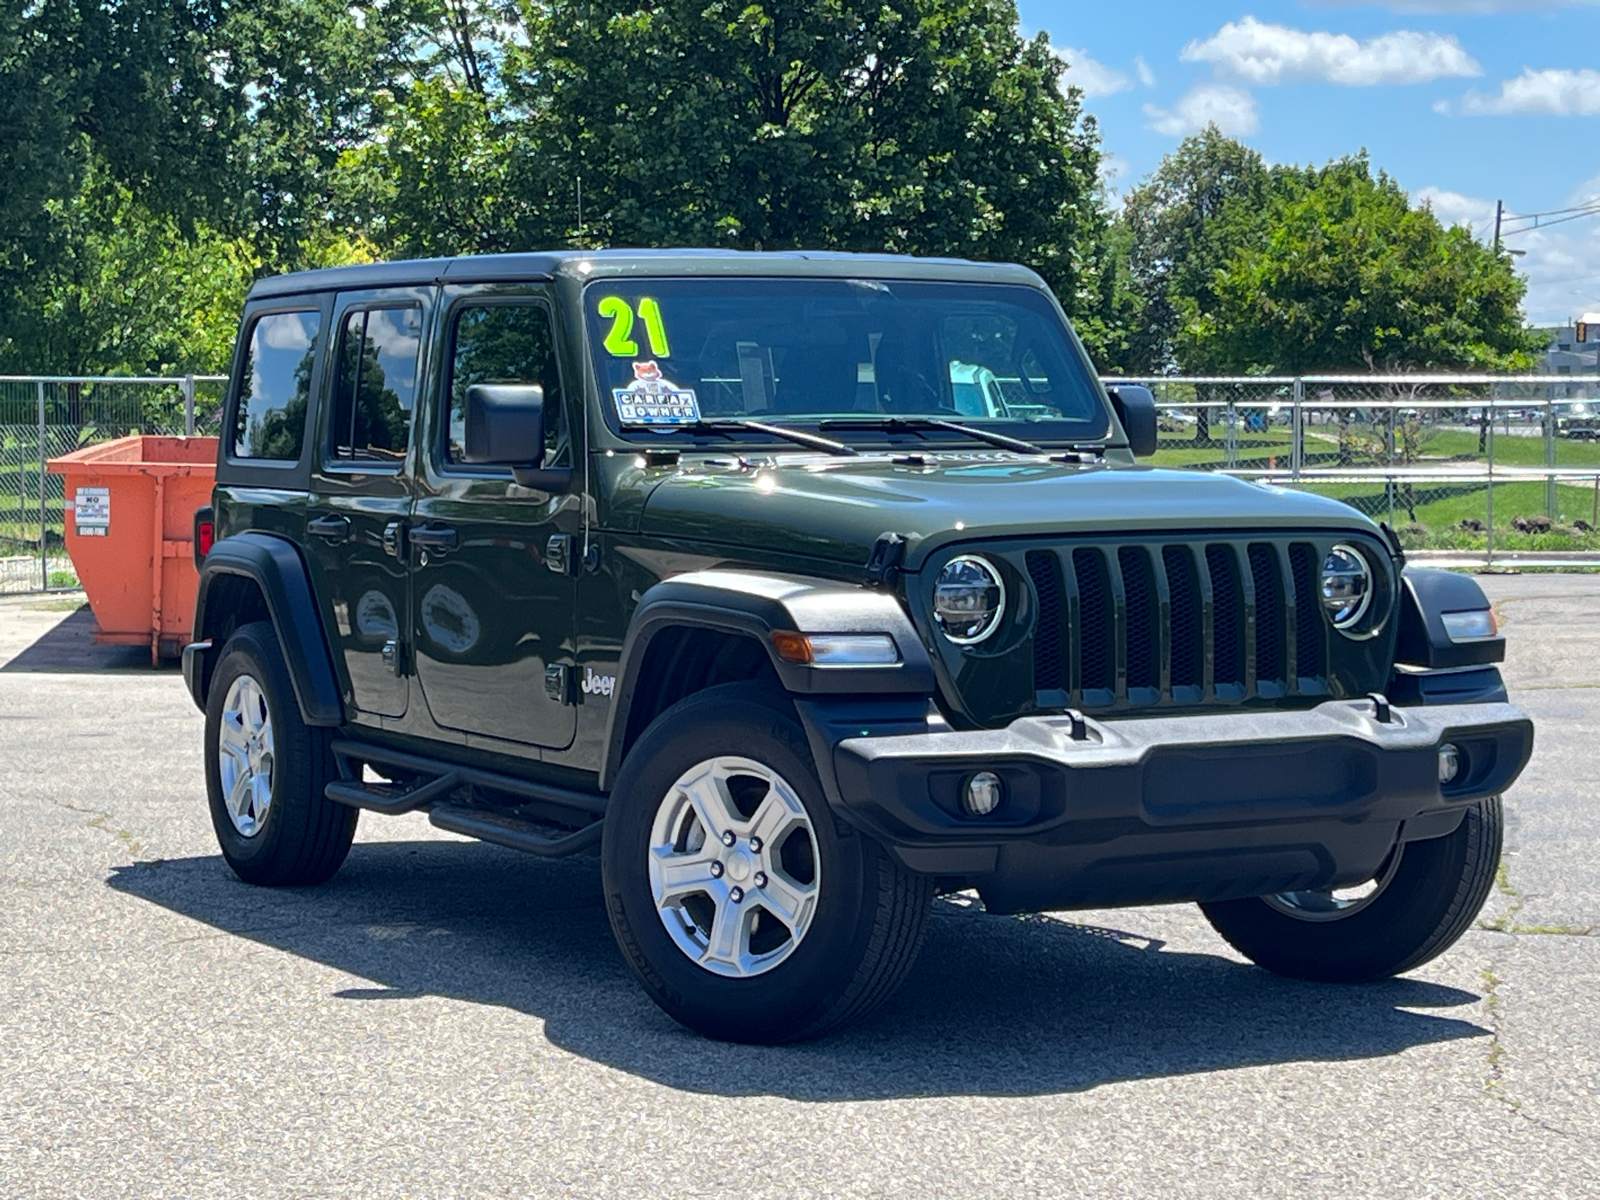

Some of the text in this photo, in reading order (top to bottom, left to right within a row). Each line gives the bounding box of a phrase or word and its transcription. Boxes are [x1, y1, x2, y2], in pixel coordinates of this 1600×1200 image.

[598, 296, 670, 358] 21
[620, 394, 692, 406] CARFAX
[636, 406, 695, 418] OWNER
